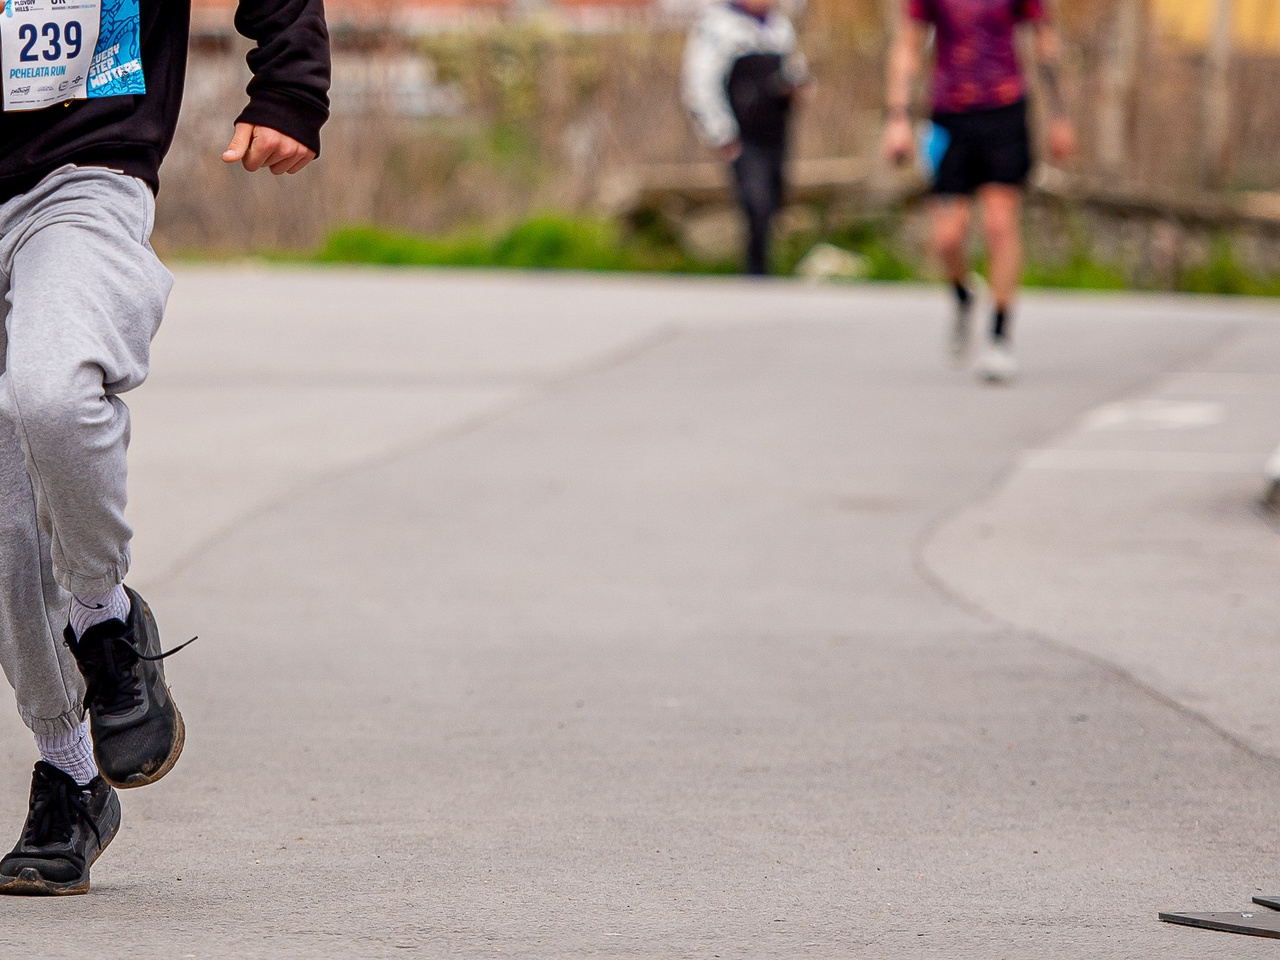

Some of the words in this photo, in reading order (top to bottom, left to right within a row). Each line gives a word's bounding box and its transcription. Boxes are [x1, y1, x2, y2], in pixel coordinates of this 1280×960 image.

[19, 20, 82, 62] 239
[10, 66, 50, 80] PCHELATA
[50, 65, 67, 77] RUN
[89, 56, 115, 78] STEP
[90, 58, 141, 88] MATTERS
